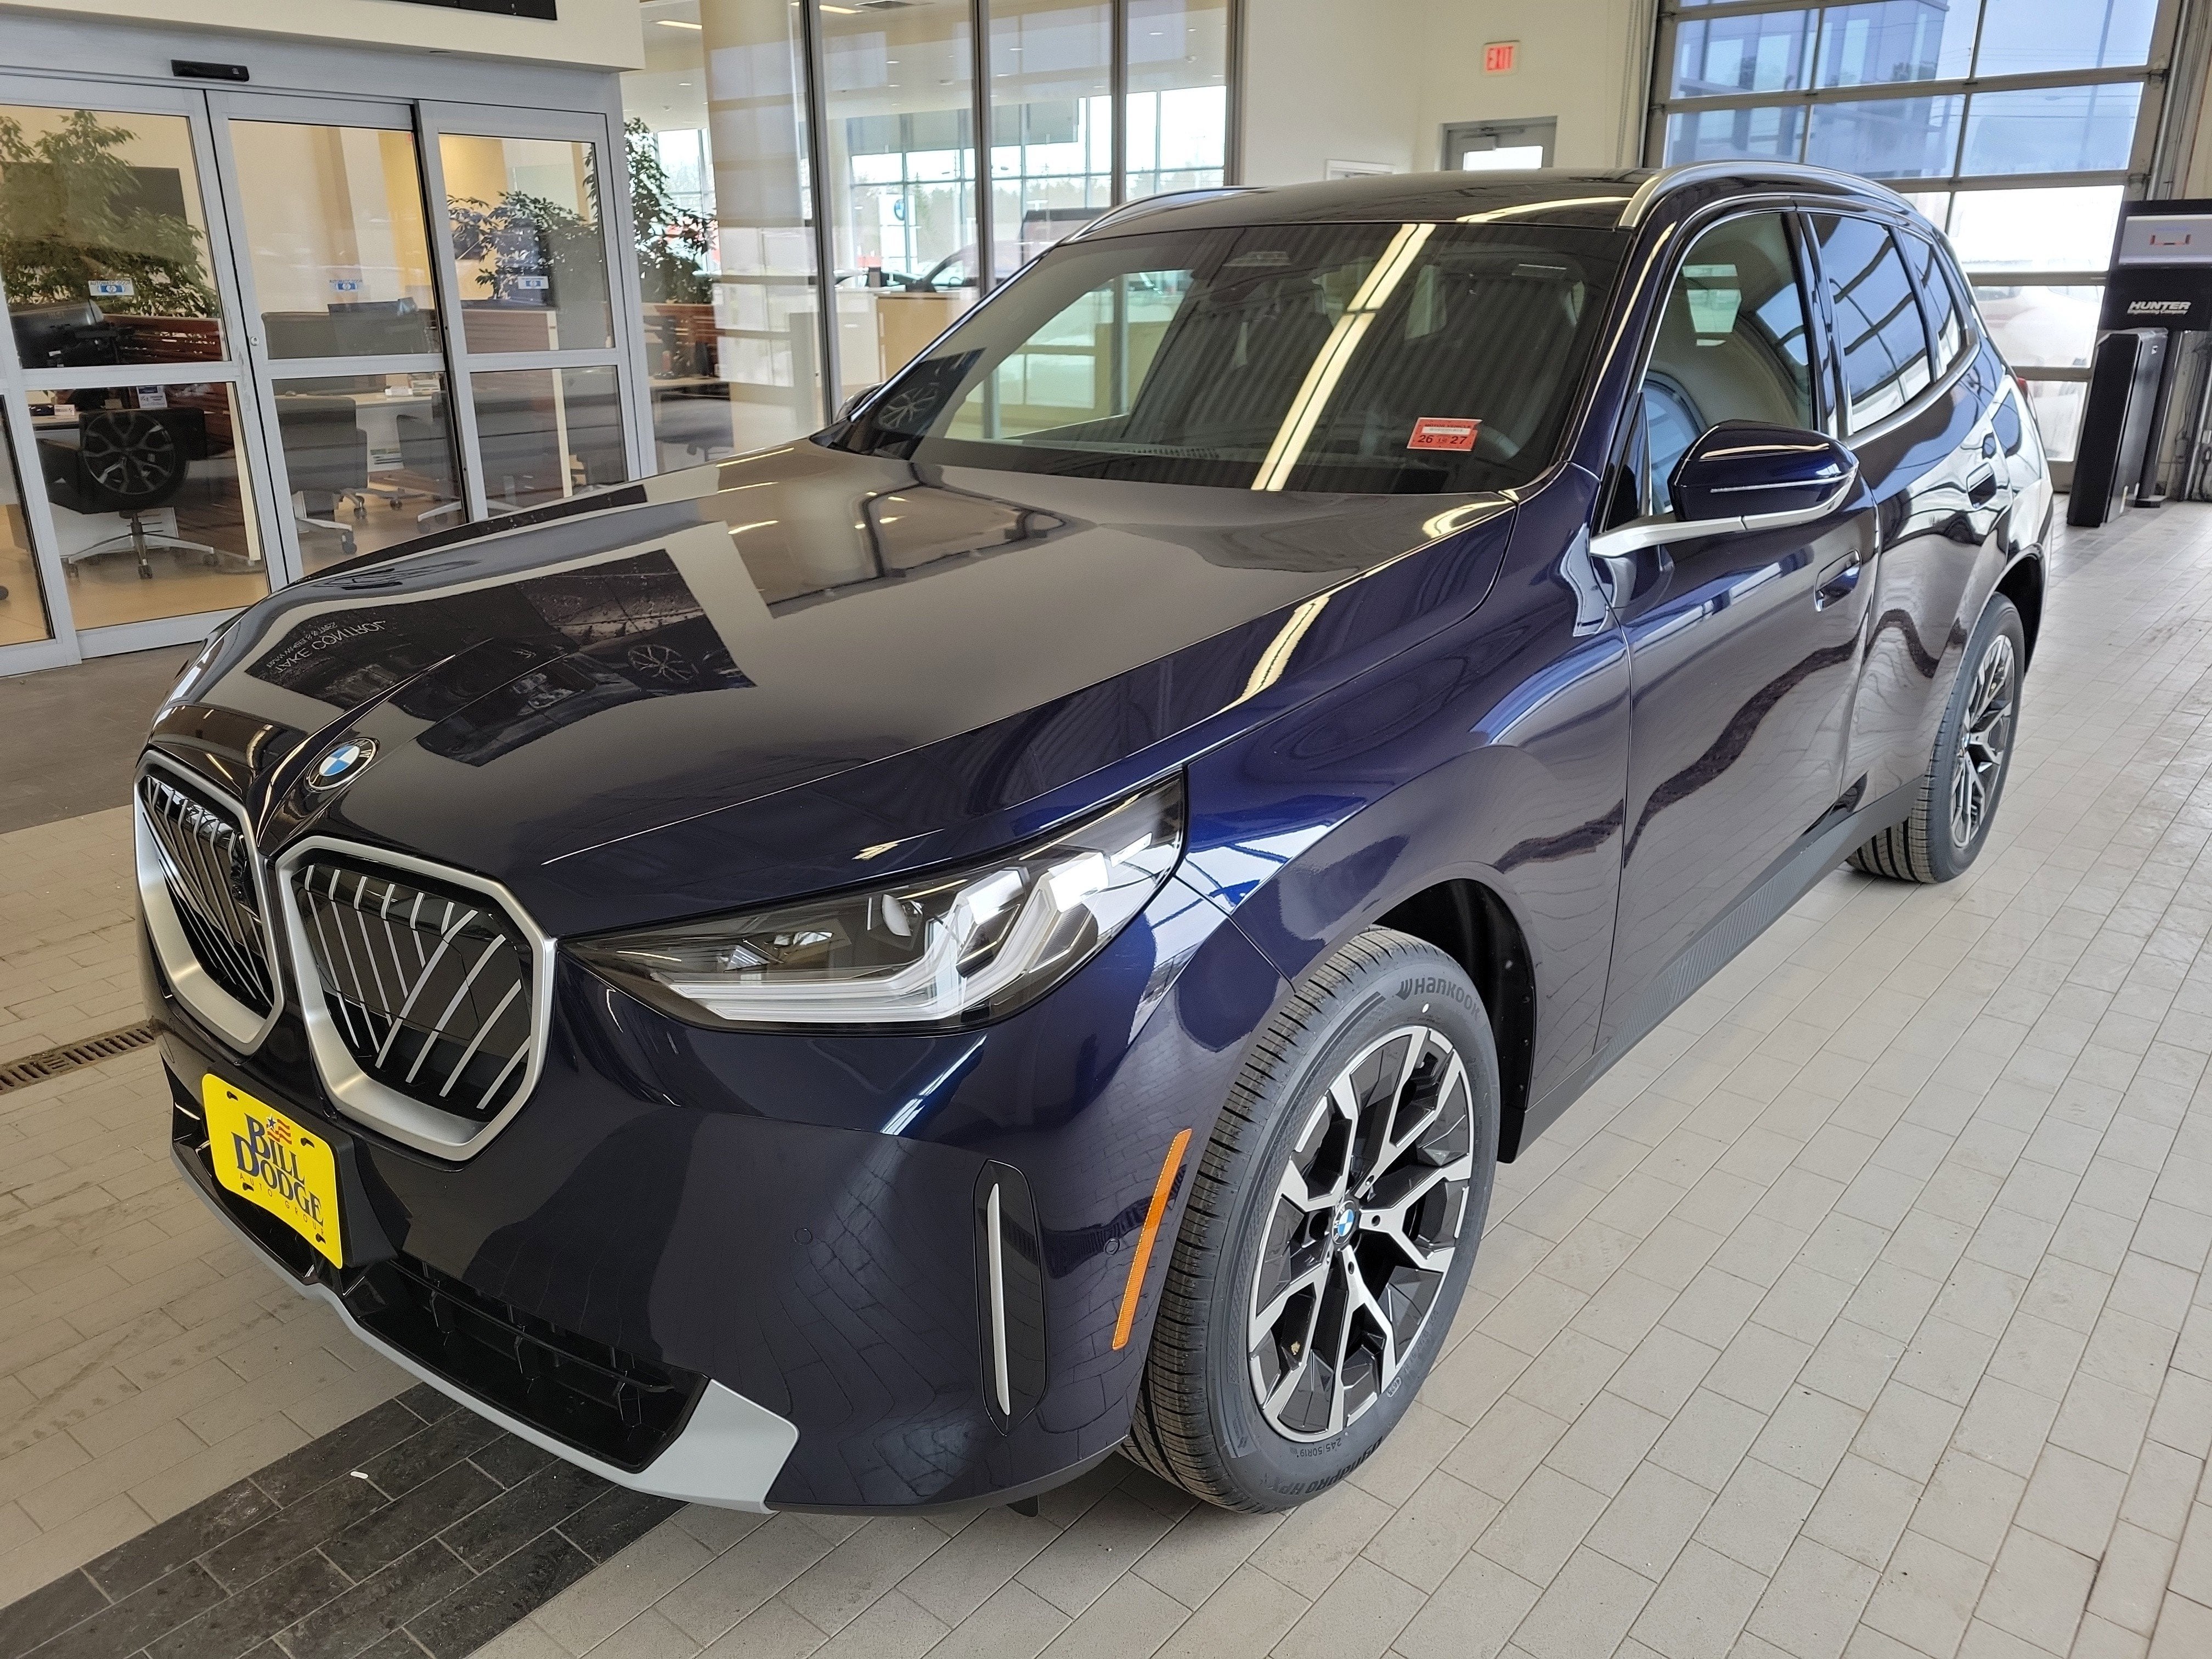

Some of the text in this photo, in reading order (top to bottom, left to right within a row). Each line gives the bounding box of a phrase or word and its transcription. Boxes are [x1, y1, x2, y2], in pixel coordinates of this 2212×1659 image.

[1487, 46, 1513, 70] EXIT
[2128, 301, 2192, 311] HUNTER
[1418, 435, 1434, 444] 26
[1450, 436, 1468, 444] 27
[244, 1113, 306, 1186] BILL
[230, 1131, 324, 1227] DODGE
[240, 1172, 324, 1235] AUTO GROUP
